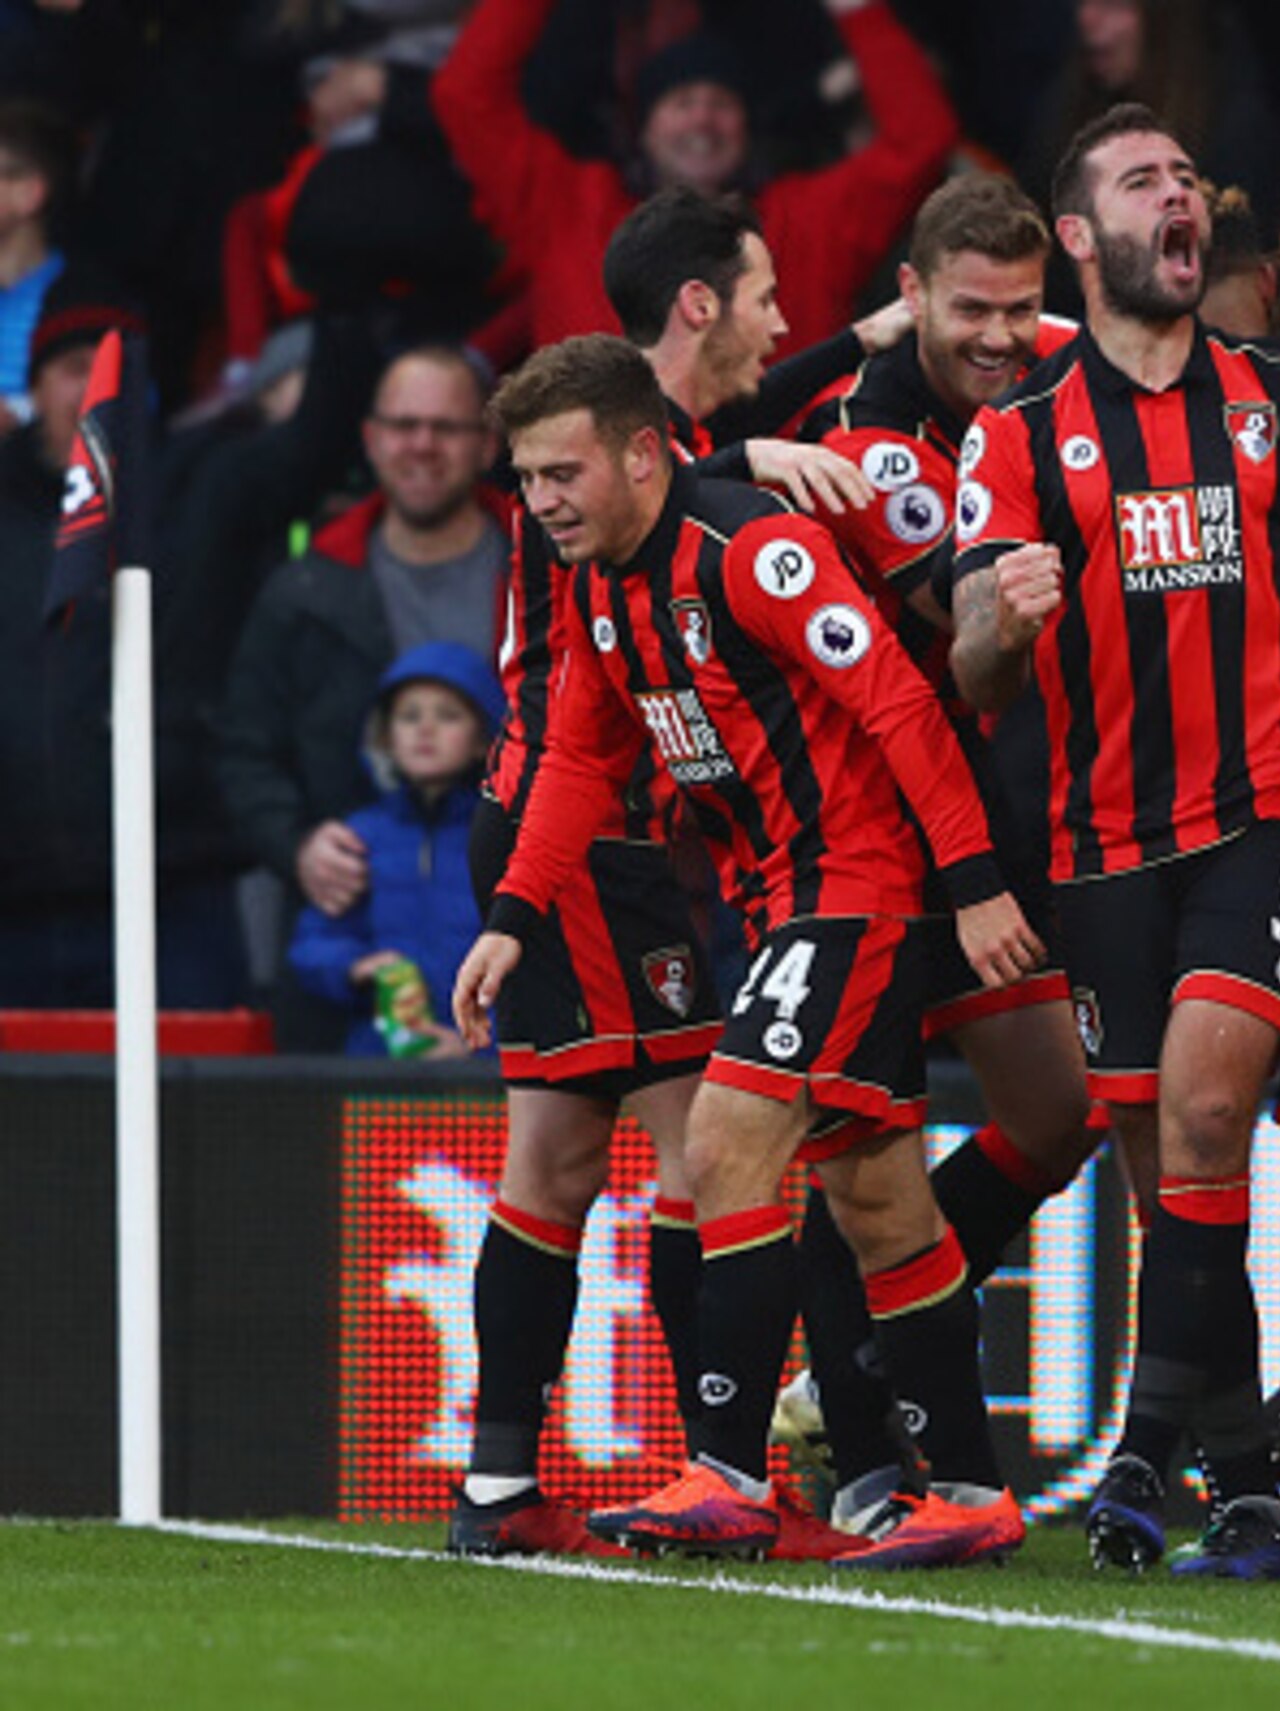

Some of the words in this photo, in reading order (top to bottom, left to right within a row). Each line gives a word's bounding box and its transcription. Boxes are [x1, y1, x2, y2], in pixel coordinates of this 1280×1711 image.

[876, 452, 911, 480] JD
[770, 548, 803, 591] JD
[1123, 560, 1243, 592] MANSION
